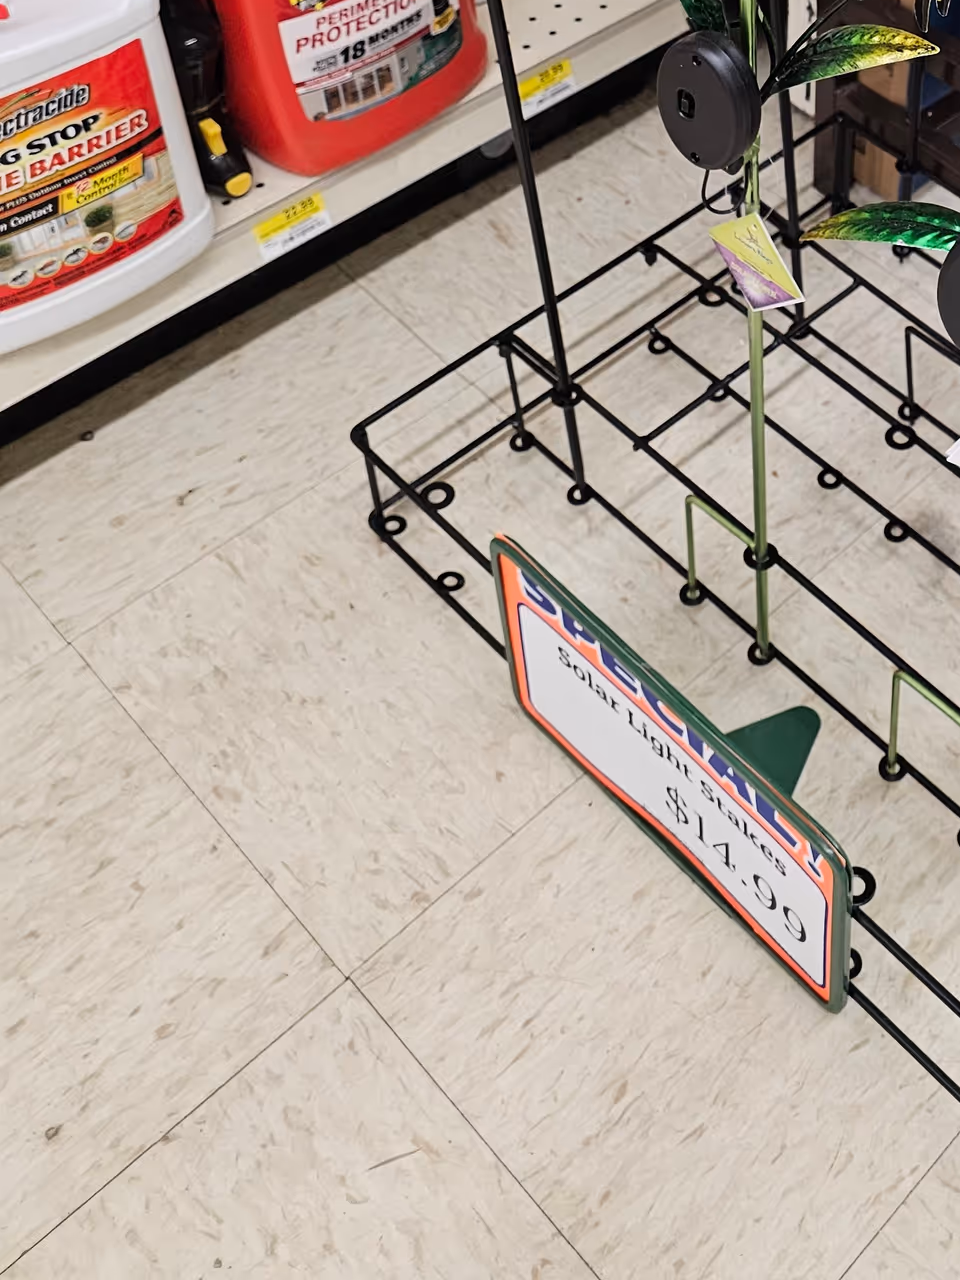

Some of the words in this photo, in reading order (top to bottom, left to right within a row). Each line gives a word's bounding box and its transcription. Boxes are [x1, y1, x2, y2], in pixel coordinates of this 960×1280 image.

[340, 39, 366, 64] 18
[367, 8, 423, 46] MONTHS
[0, 82, 91, 141] ctracide
[26, 113, 101, 155] STOP
[29, 113, 144, 180] BARRIER
[75, 179, 118, 206] Control
[91, 163, 130, 189] Month
[10, 202, 54, 228] Contact
[557, 646, 621, 716] Solar
[627, 707, 692, 781] Light
[698, 778, 788, 878] Stakes
[664, 784, 807, 944] $14.99
